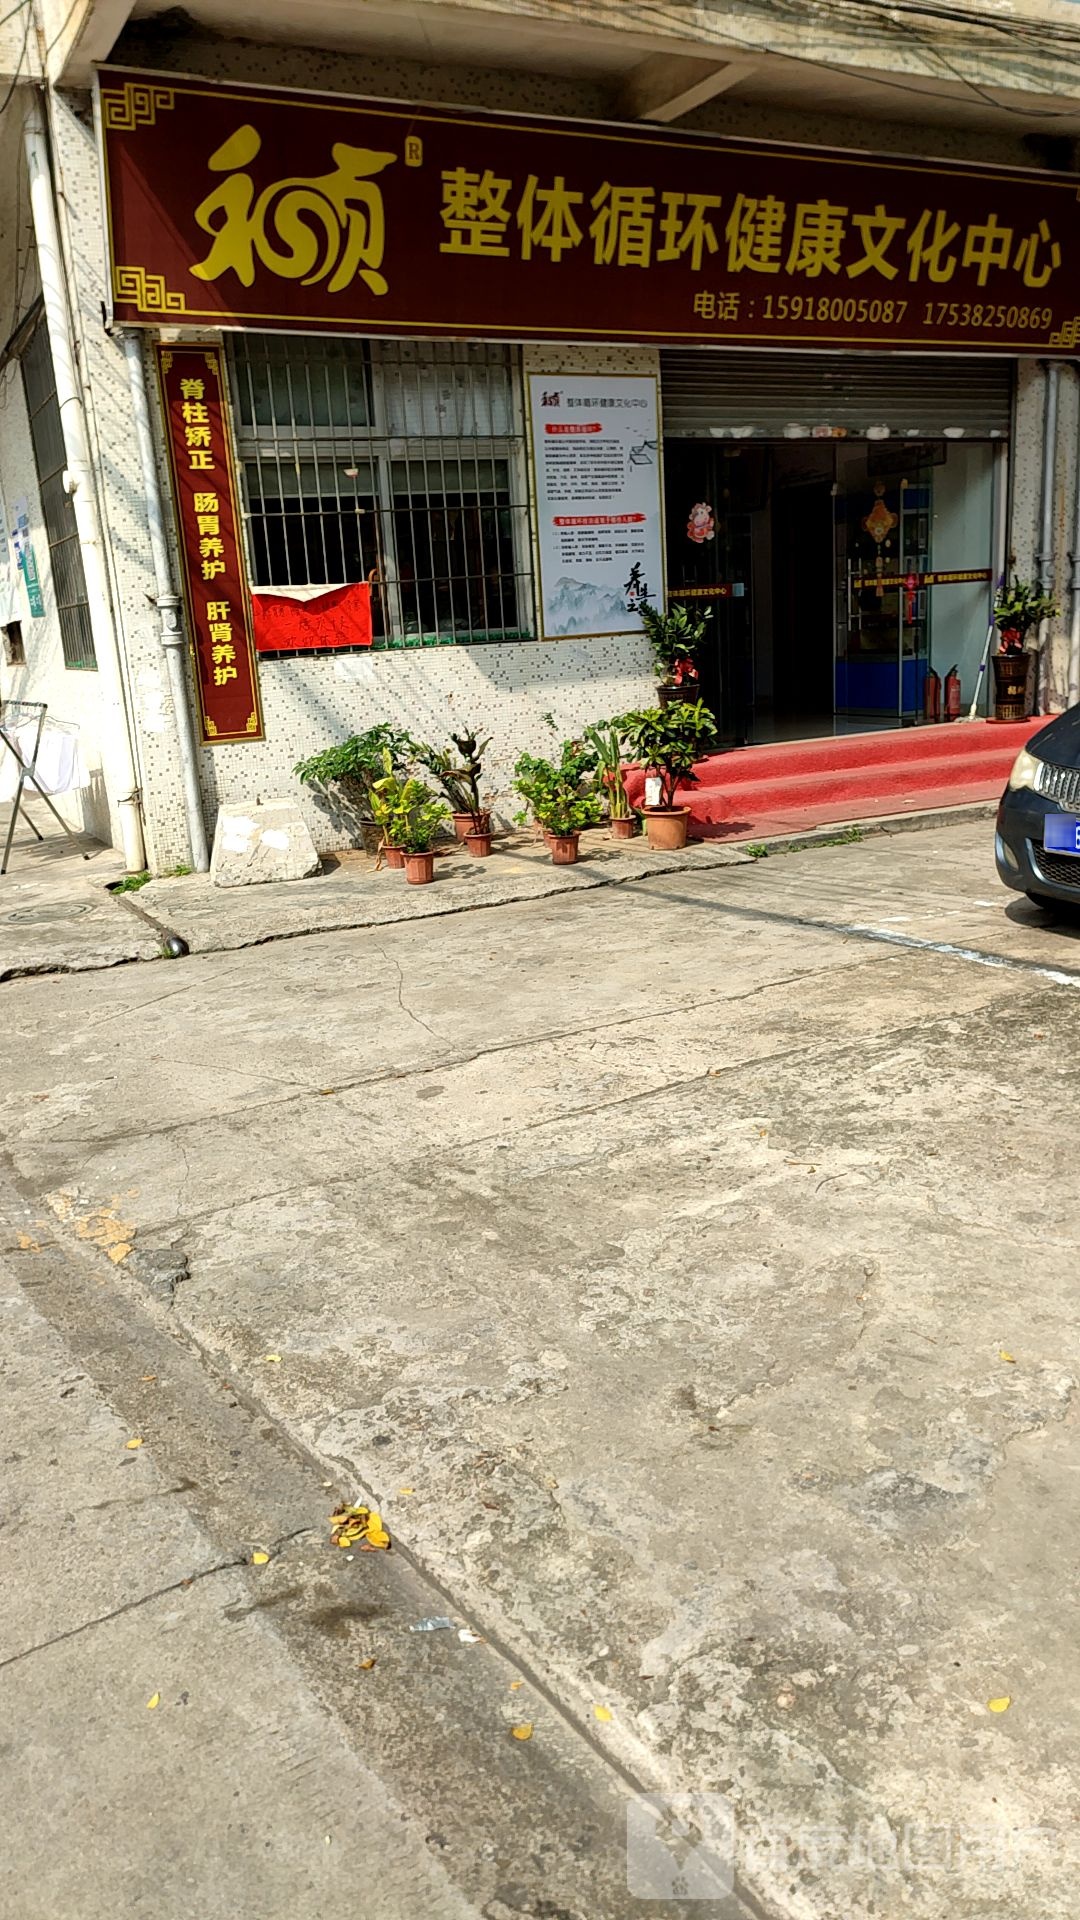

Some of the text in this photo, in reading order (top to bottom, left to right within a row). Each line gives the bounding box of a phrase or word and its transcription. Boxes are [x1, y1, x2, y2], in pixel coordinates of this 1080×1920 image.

[438, 166, 1062, 289] 整体循环健康文化中心
[922, 301, 1054, 330] 17538250869
[180, 378, 216, 471] 脊柱矫正
[193, 492, 226, 581] 肠胃养护
[206, 600, 238, 687] 肝肾养护
